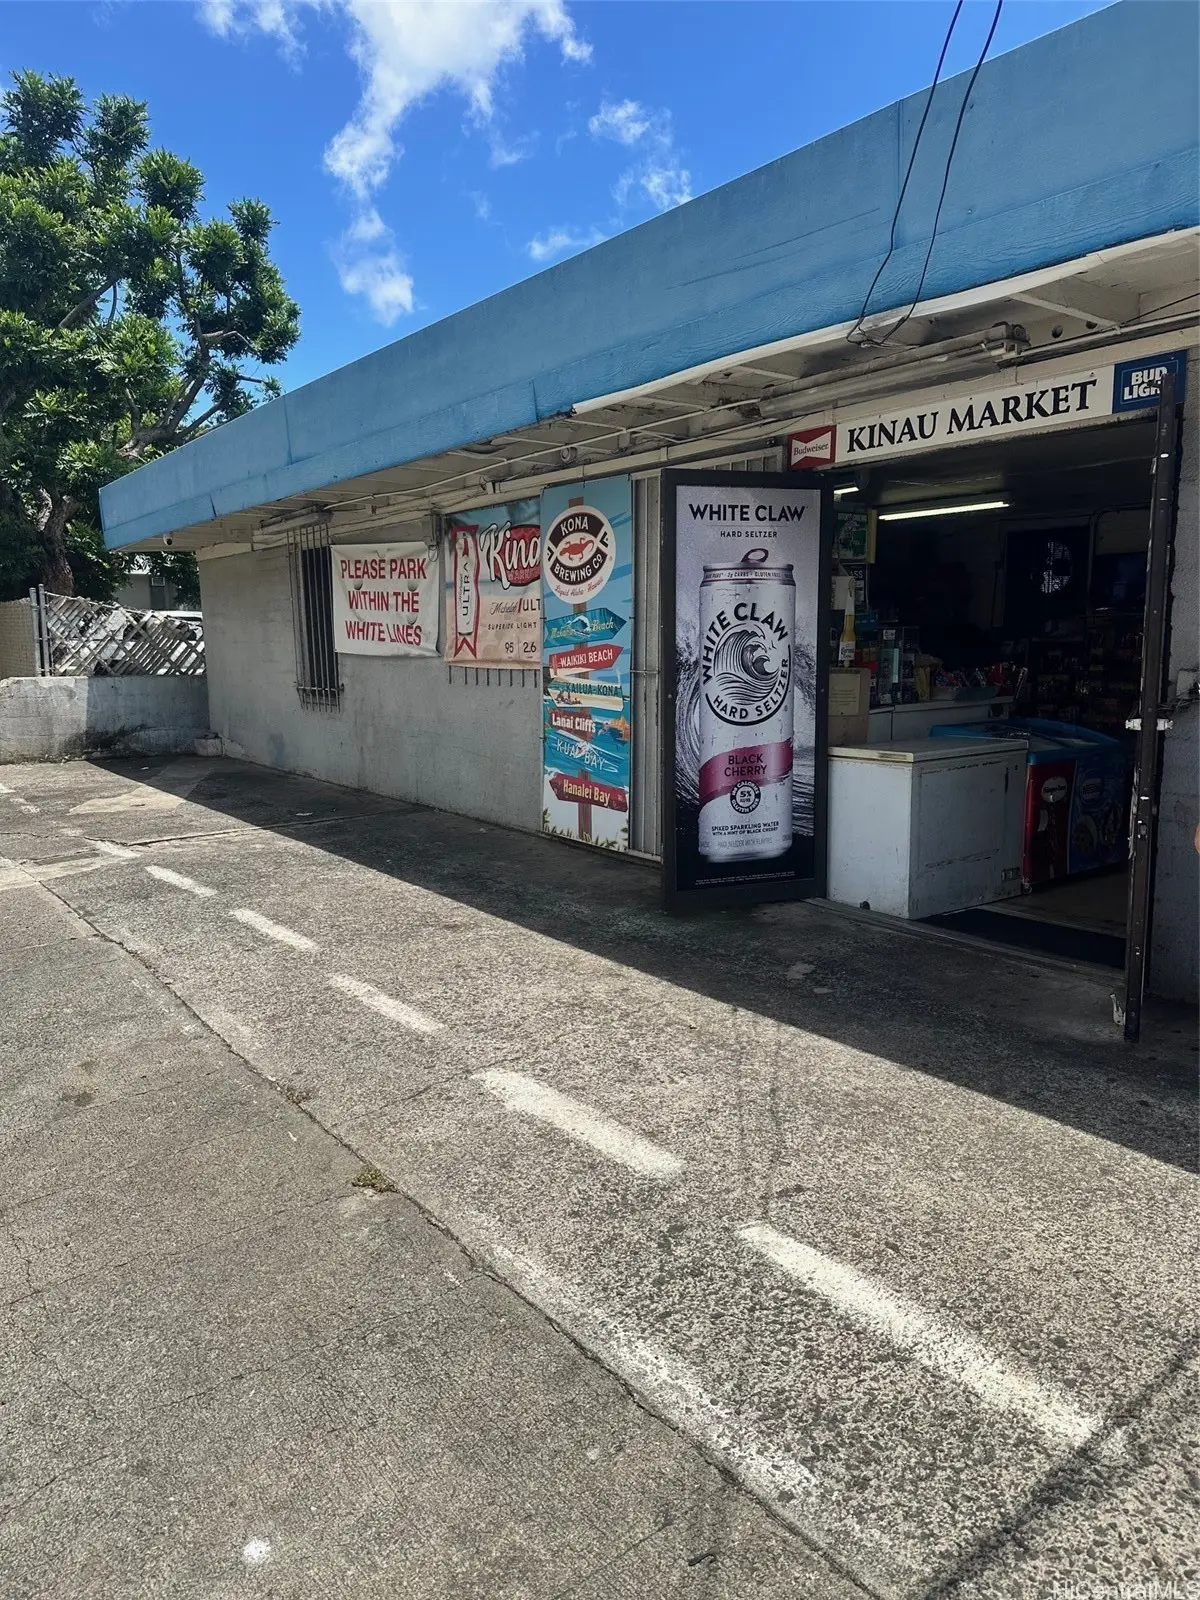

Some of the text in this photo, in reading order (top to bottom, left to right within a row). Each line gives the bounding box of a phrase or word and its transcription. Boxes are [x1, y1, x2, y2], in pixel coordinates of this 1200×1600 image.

[1123, 383, 1161, 400] LIGH
[846, 378, 1098, 453] KINAU MARKET
[793, 442, 830, 456] Budweiser
[688, 503, 805, 522] WHITE CLAW
[560, 516, 589, 537] KONA
[720, 530, 778, 539] HARD SELTZER
[480, 521, 540, 589] Kina
[340, 557, 428, 580] PLEASE PARK
[554, 563, 592, 582] BREWING
[347, 590, 420, 613] WITHIN THE
[522, 598, 541, 611] ULT
[345, 619, 422, 647] WHITE LINES
[516, 621, 537, 629] LIGHT
[505, 642, 514, 653] 95
[702, 602, 789, 684] WHITE CLAW
[560, 648, 613, 667] WAIKIKI BEACH
[566, 682, 619, 697] KAILUA-KONA
[713, 694, 748, 719] HARD
[755, 658, 788, 717] SELTZER
[552, 713, 597, 733] Lanai Cliffs
[584, 751, 606, 770] BAY
[728, 753, 763, 765] BLACK
[724, 764, 768, 777] CHERRY
[563, 779, 610, 806] Hanalei Bay
[730, 822, 762, 831] SPARKLING
[762, 820, 779, 828] WATER
